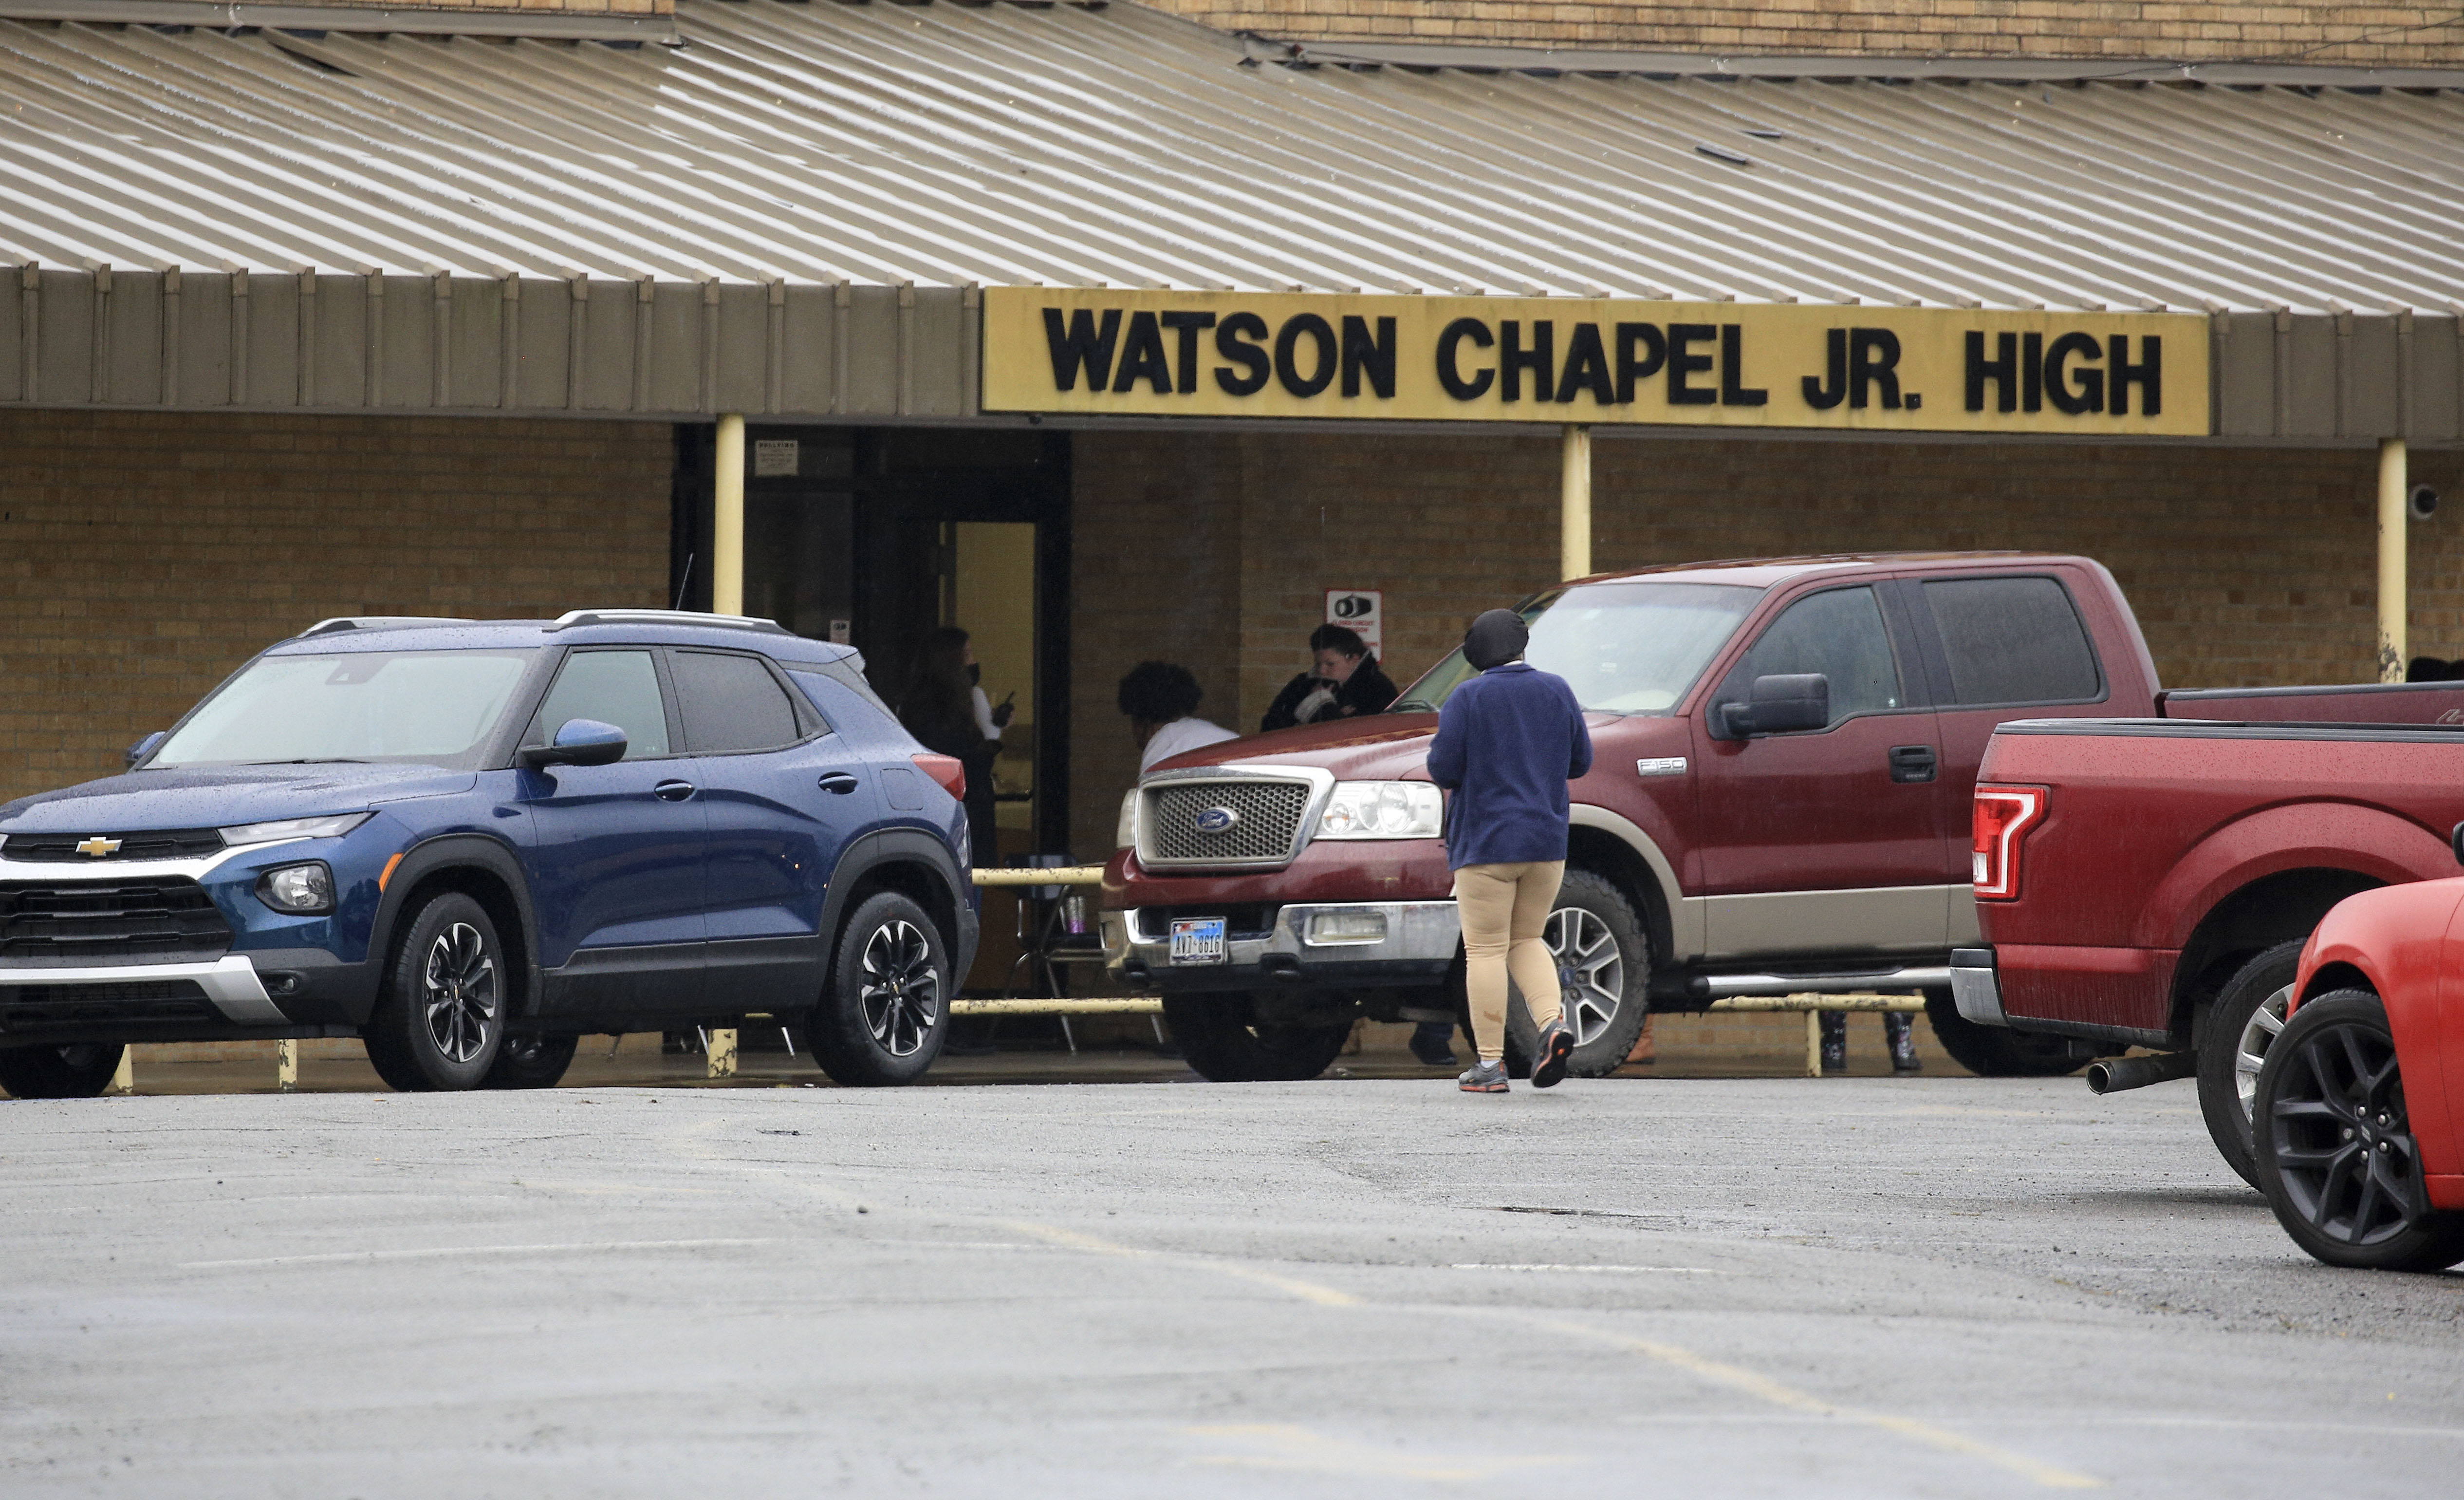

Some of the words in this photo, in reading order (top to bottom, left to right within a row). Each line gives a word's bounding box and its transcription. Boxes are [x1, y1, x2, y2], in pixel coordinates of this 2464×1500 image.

[1042, 308, 1396, 399] WATSON
[1435, 318, 1768, 408] CHAPEL
[1801, 328, 1921, 411] JR.
[1964, 331, 2161, 417] HIGH
[1202, 812, 1224, 827] Ford
